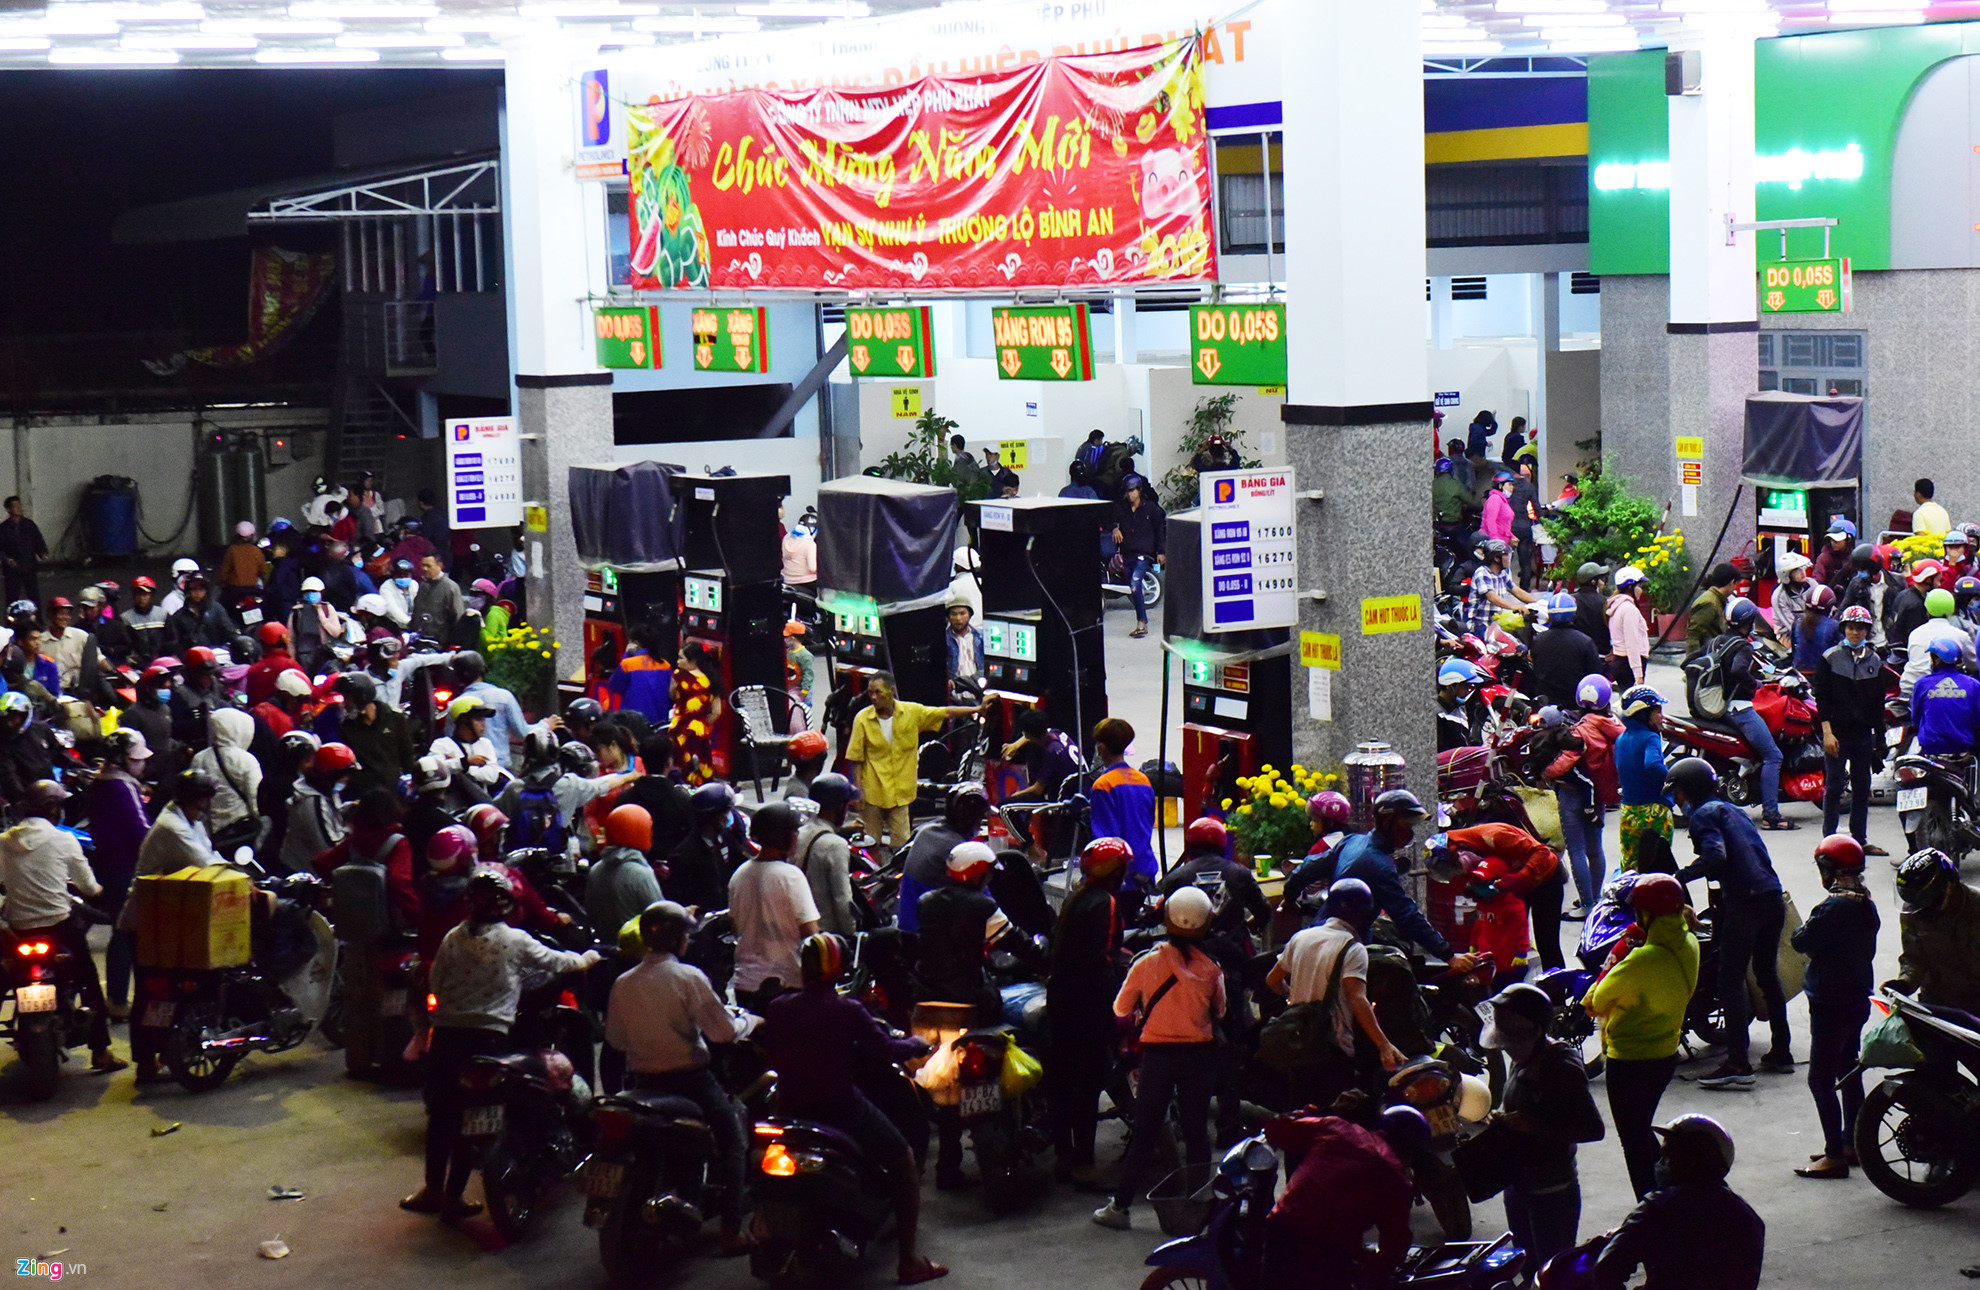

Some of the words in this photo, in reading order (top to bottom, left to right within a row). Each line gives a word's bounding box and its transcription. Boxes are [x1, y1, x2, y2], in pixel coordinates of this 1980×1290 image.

[712, 135, 789, 194] Chúc
[800, 138, 897, 208] Mừng
[909, 127, 997, 184] Năm
[1011, 114, 1091, 174] Mới
[716, 228, 737, 247] Kính
[738, 227, 764, 246] Chúc
[766, 228, 786, 249] Quý
[788, 225, 821, 247] Khách
[821, 221, 854, 253] VẠN
[938, 212, 1008, 250] THƯỢNG
[1012, 205, 1034, 247] LỘ
[1039, 203, 1081, 239] BÌNH
[1087, 206, 1114, 236] AN
[1767, 267, 1790, 287] DO
[1793, 264, 1834, 289] 0,05S
[850, 312, 873, 339] DO
[874, 311, 912, 343] 0,05S
[993, 309, 1029, 347] XĂNG
[1029, 316, 1057, 347] RON
[1057, 316, 1074, 346] 95
[1197, 310, 1226, 341] DO
[1229, 309, 1279, 345] 0,05S
[1270, 475, 1285, 487] GIÁ
[1258, 526, 1292, 538] 17600
[1258, 553, 1293, 564] 16270
[1258, 578, 1293, 590] 14900
[1927, 686, 1967, 699] adidas
